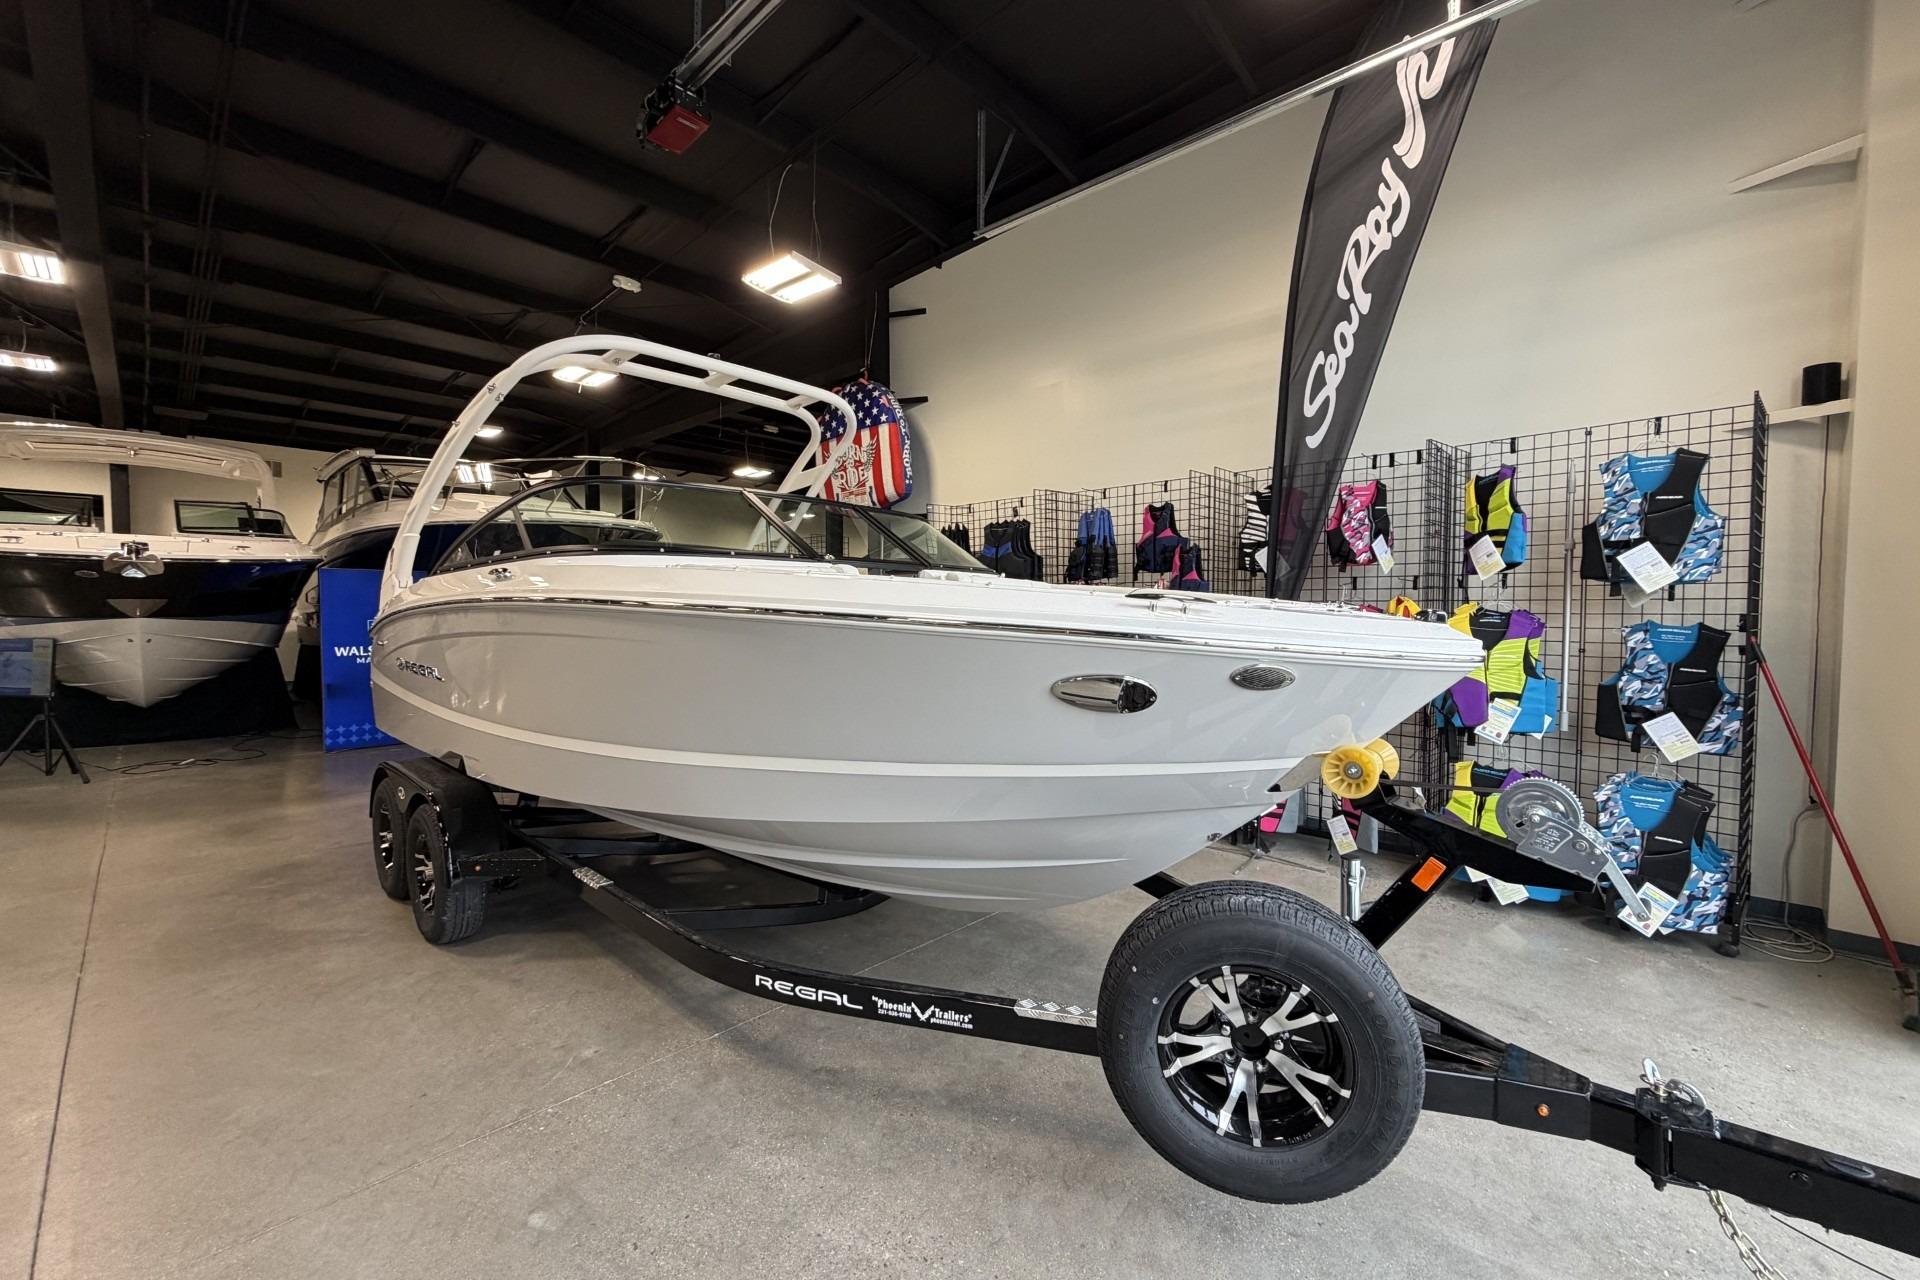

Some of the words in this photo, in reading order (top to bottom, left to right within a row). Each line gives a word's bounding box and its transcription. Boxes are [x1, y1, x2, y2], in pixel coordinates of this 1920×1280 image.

[1304, 303, 1359, 449] Sea
[1337, 157, 1410, 315] Ray
[405, 660, 445, 682] REGAL
[755, 974, 863, 1010] REGAL
[878, 999, 912, 1013] Phoenix
